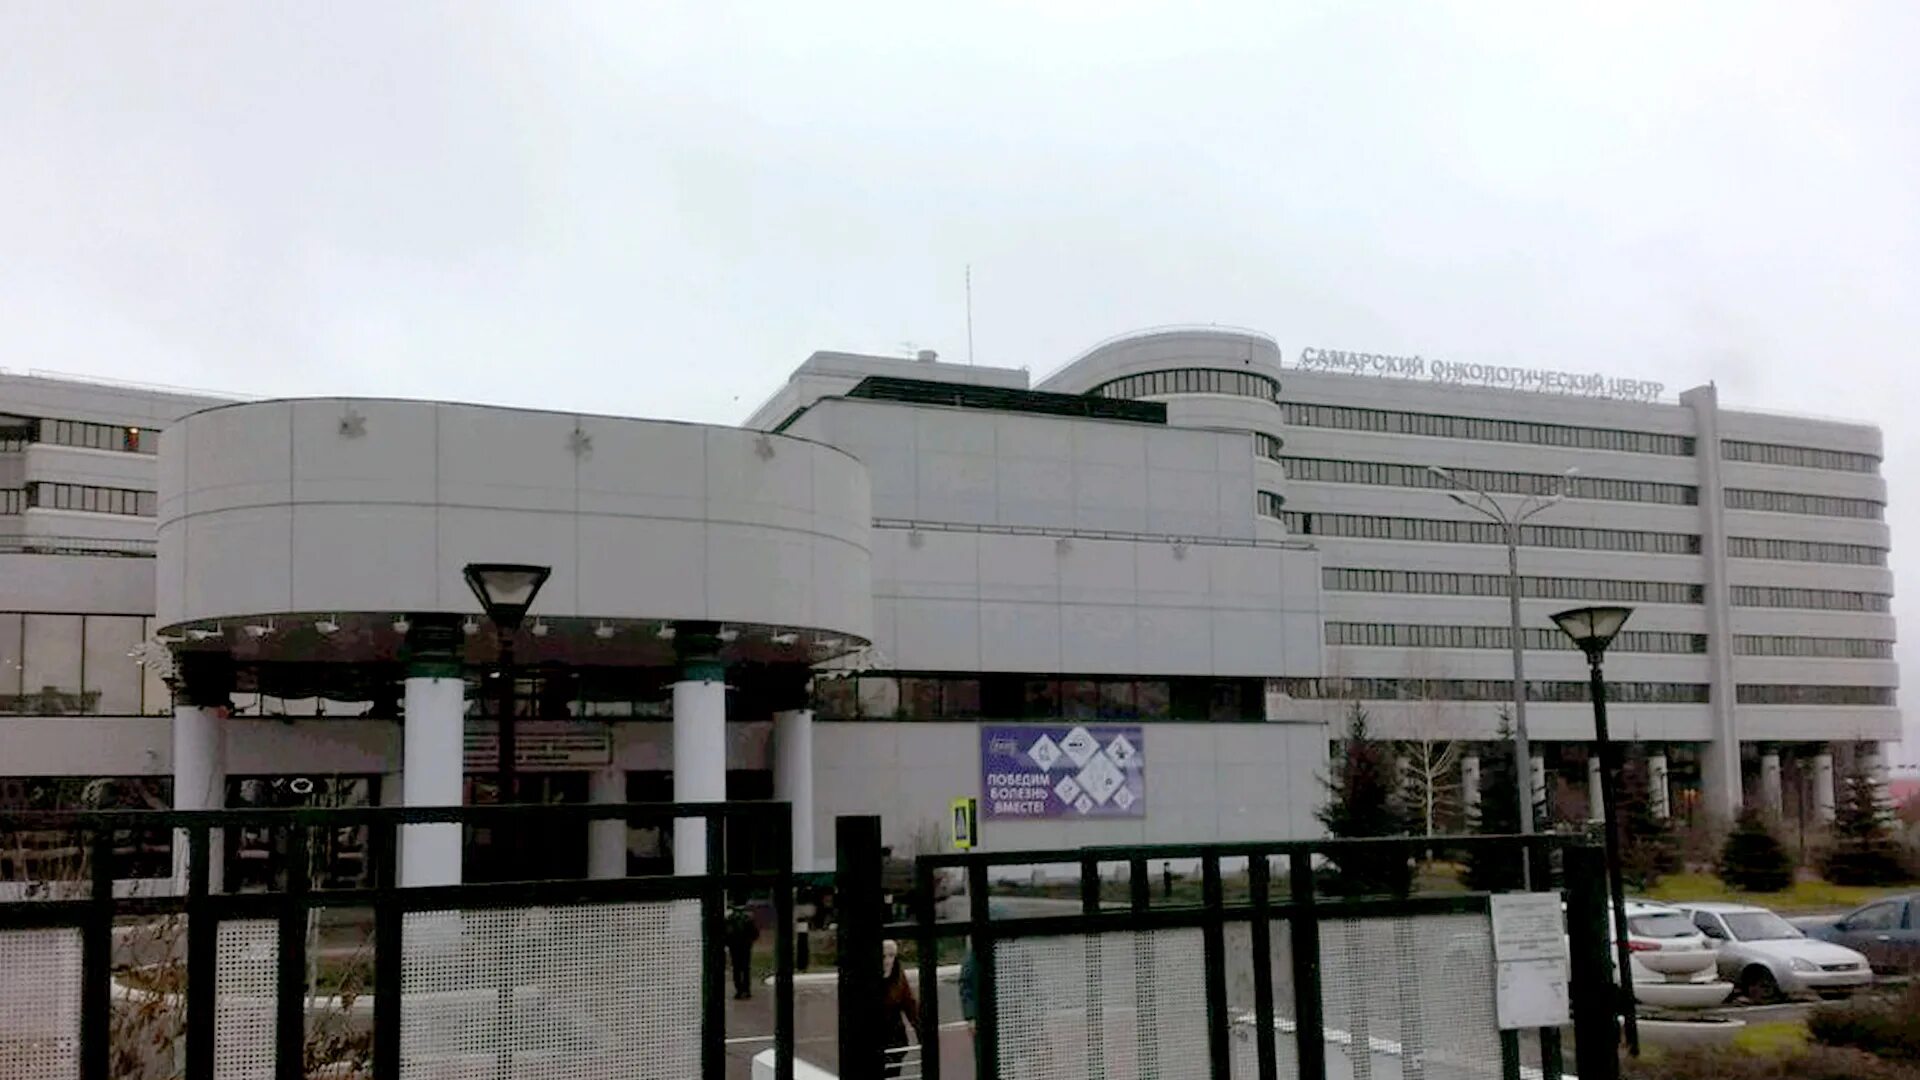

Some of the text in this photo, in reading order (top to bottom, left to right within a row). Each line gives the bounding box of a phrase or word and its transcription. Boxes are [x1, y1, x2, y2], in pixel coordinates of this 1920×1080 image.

[1302, 347, 1665, 398] САМАРСКИЙ ОНКОЛОГИЧЕСКИЙ ЦЕНТР
[987, 773, 1050, 786] ПОБЕДИМ
[990, 787, 1048, 799] БОЛЕЗНЬ
[994, 801, 1045, 813] ВМЕСТЕ!
